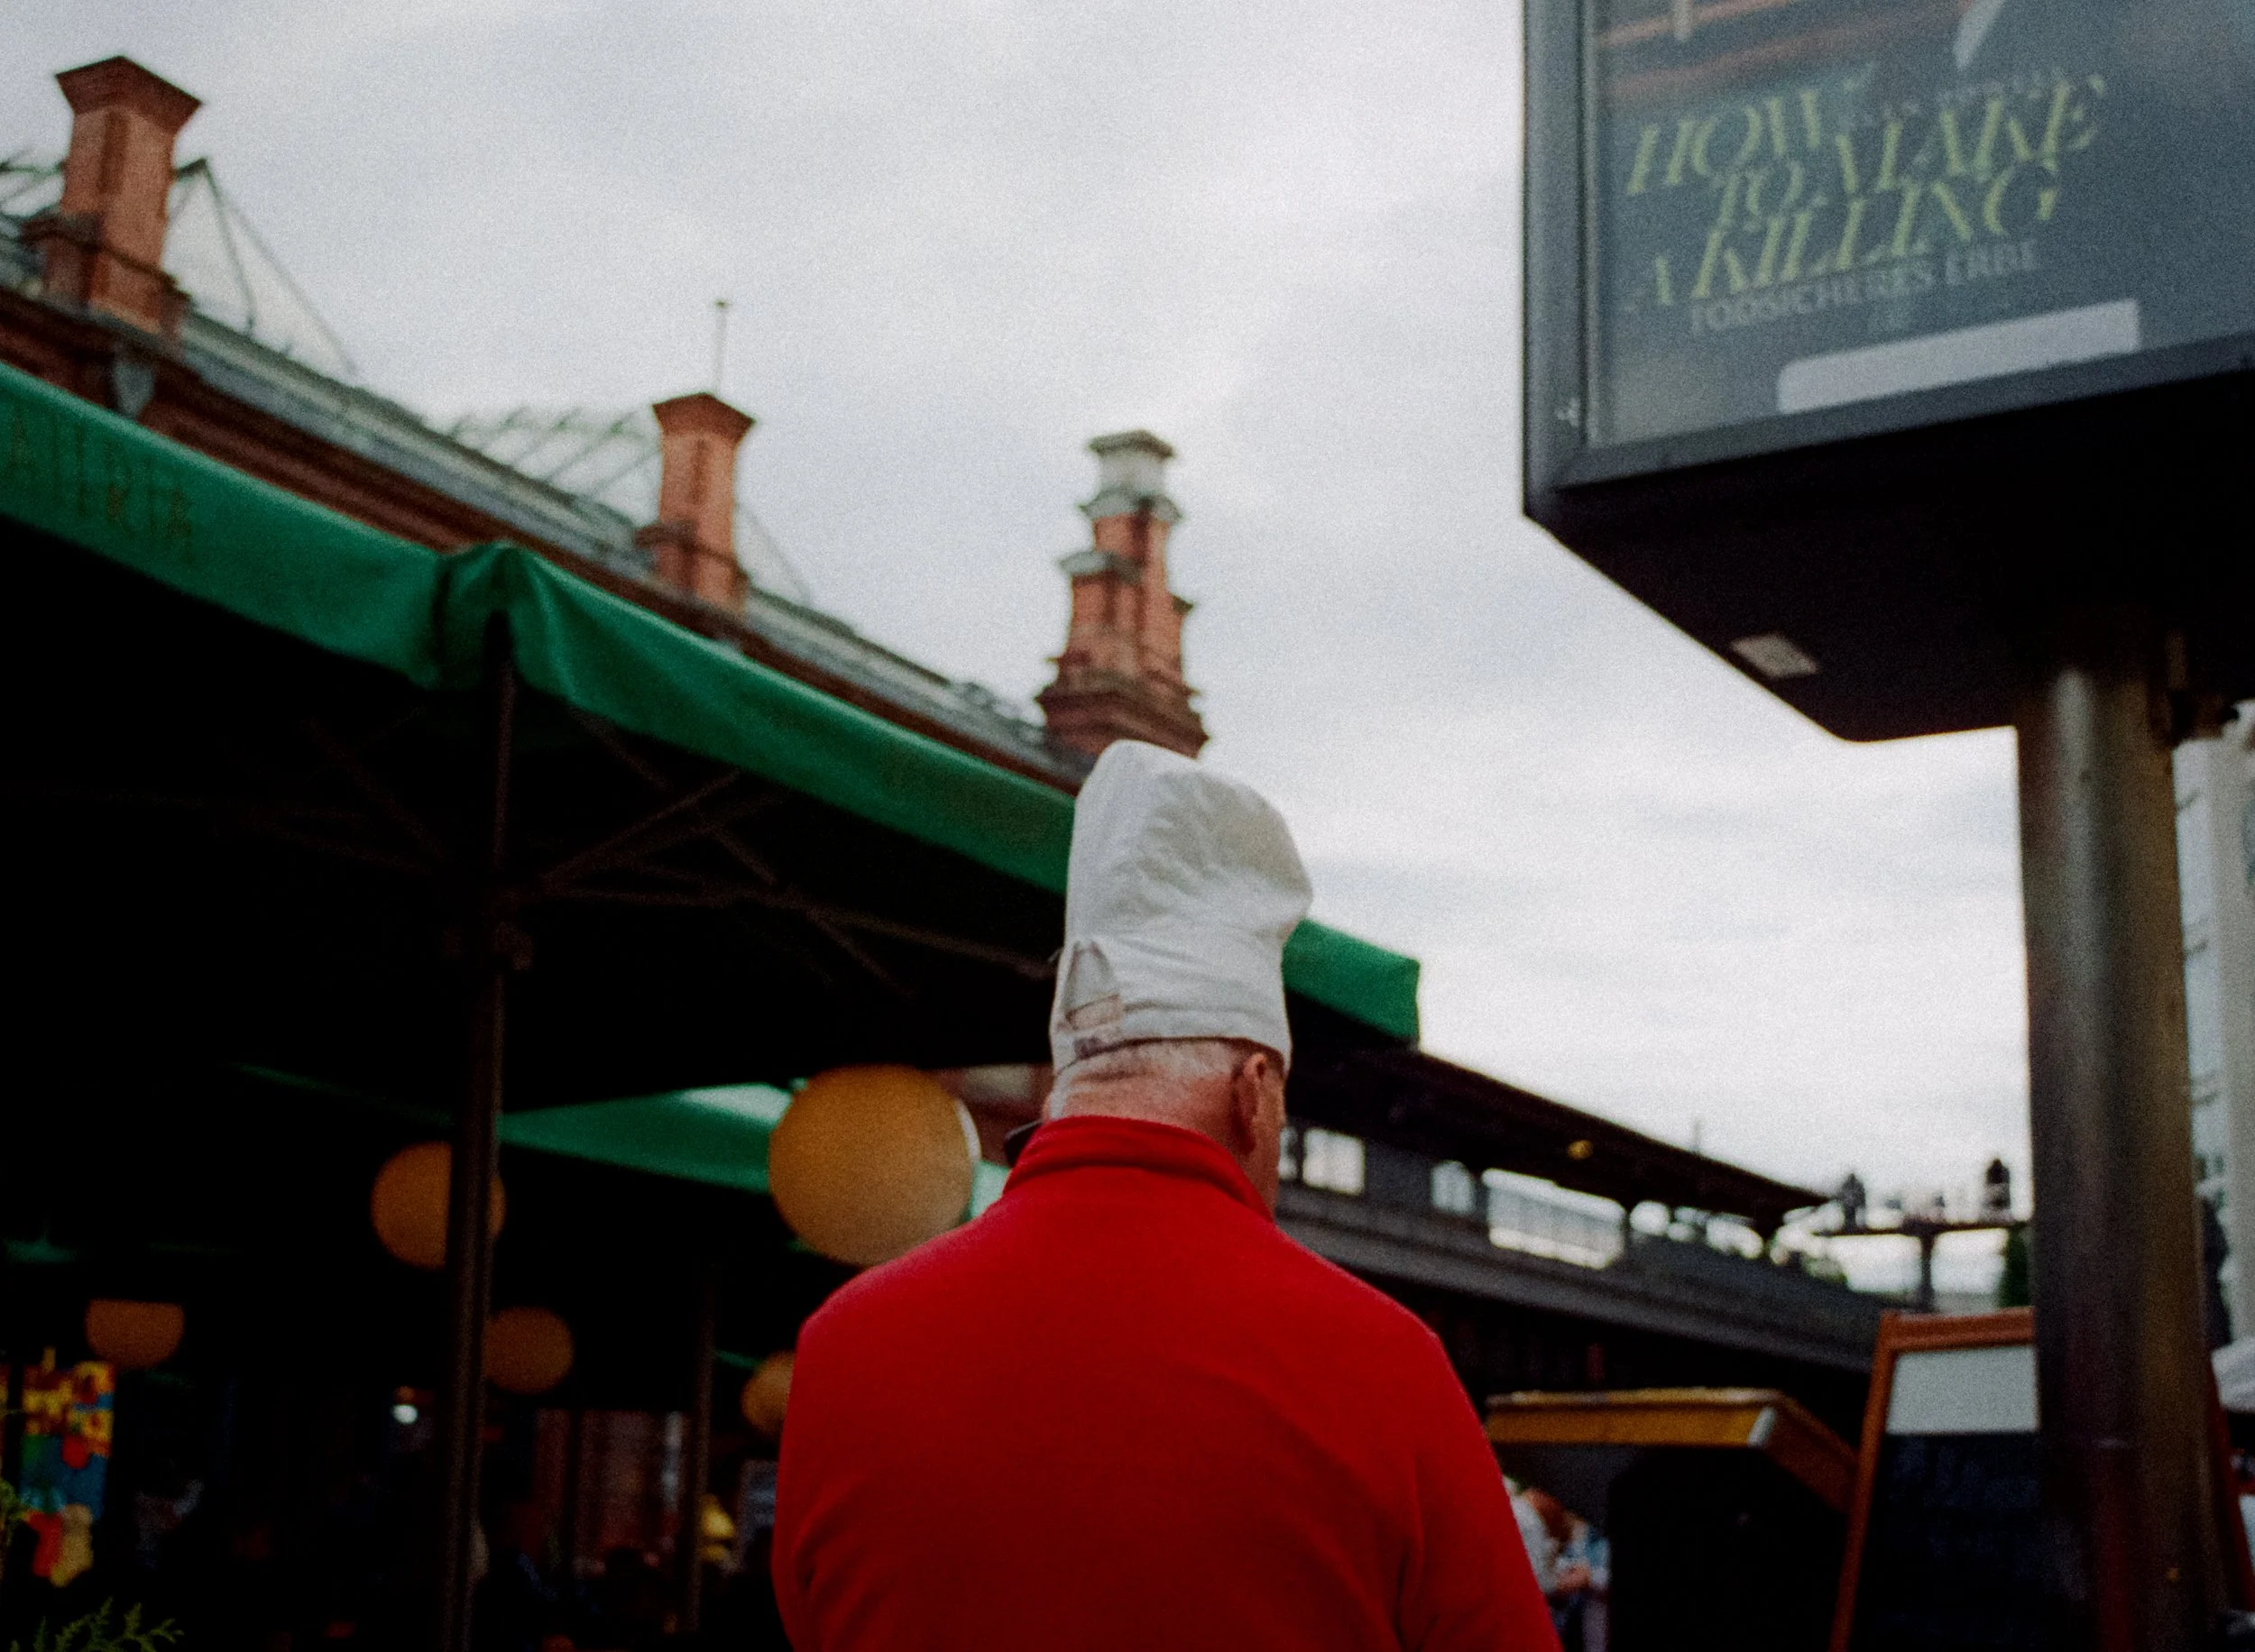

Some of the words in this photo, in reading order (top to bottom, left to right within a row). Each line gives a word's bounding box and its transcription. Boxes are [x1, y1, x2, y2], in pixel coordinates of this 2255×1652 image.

[1625, 79, 1864, 196] HOW
[1711, 161, 1805, 231] TO
[1815, 74, 2107, 206] MAKE
[1690, 154, 2061, 299] KILLING
